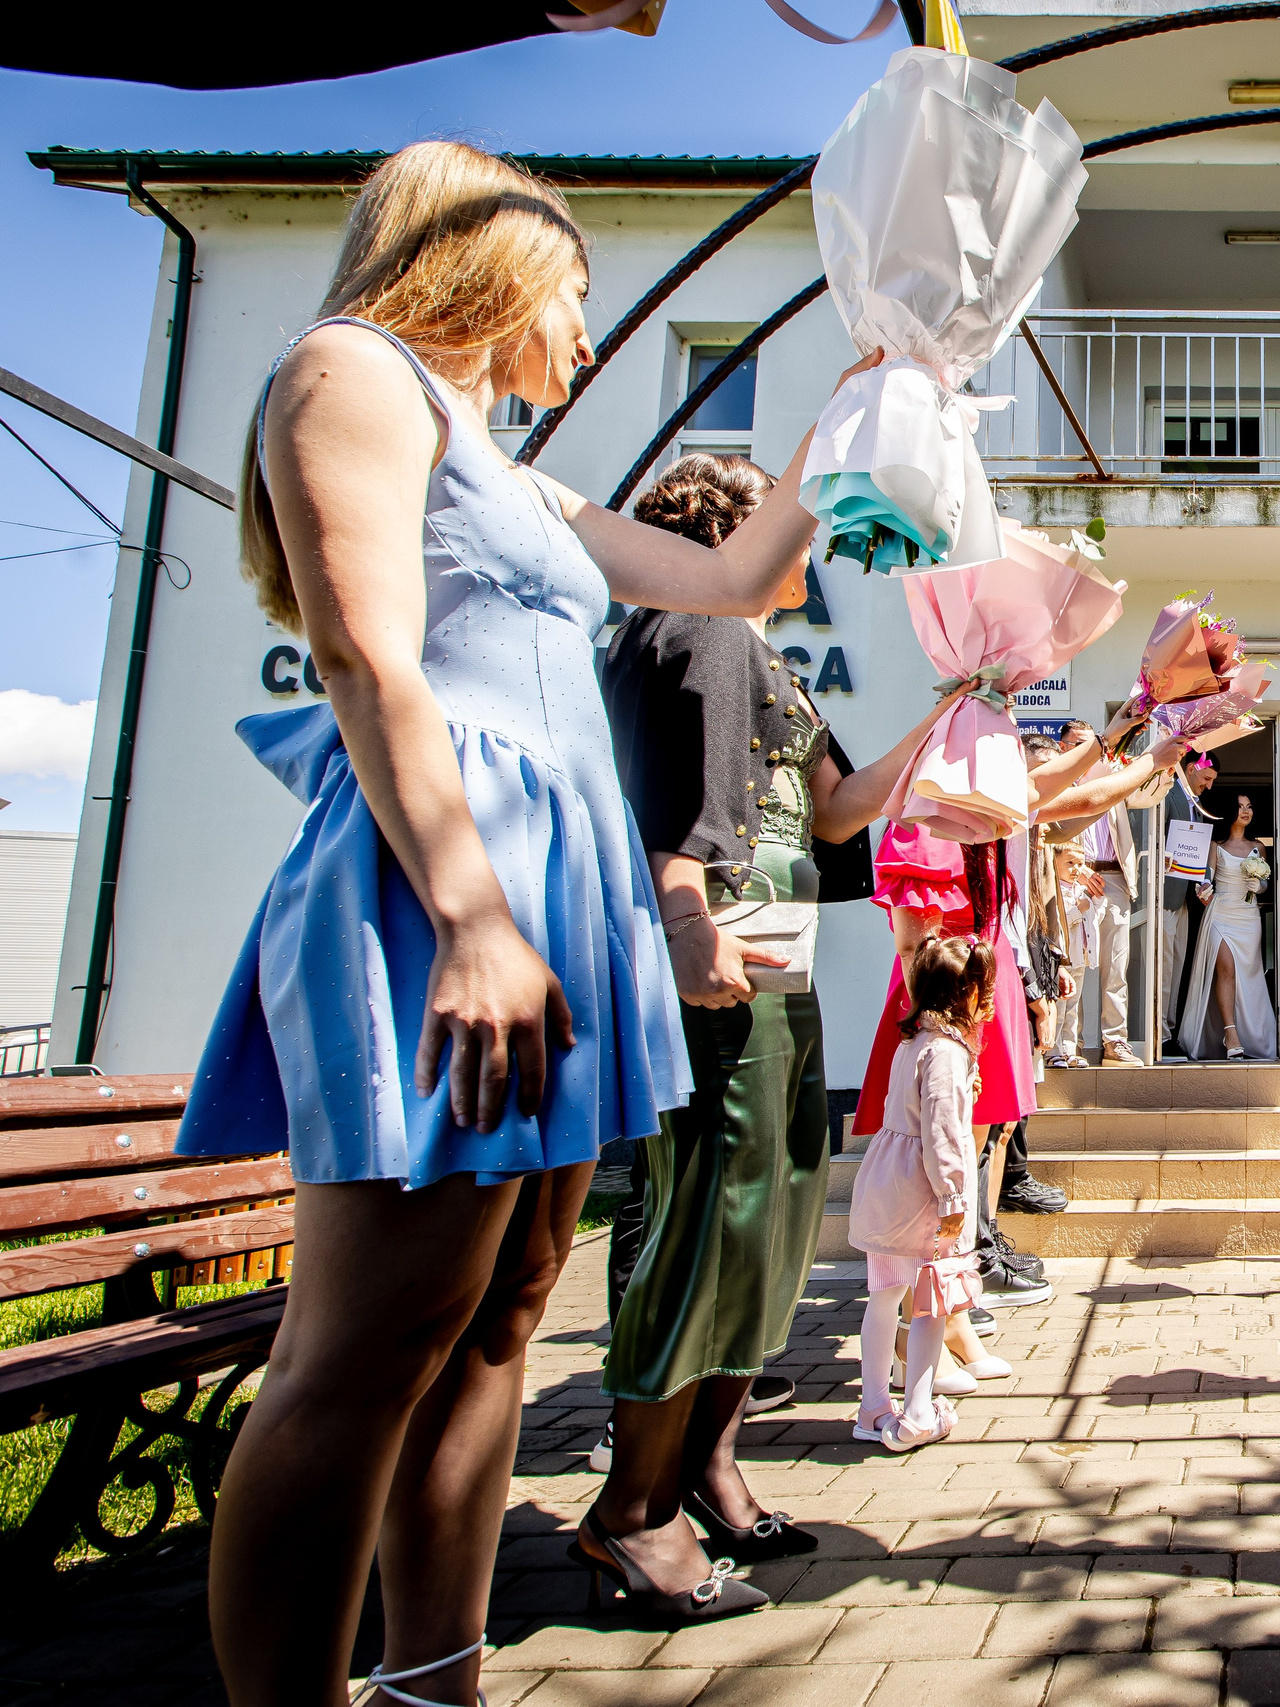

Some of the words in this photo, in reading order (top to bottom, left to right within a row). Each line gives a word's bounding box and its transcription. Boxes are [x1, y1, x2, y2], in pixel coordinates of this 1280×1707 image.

[1043, 725, 1056, 735] Nr.
[1177, 843, 1198, 852] Mapa
[1173, 850, 1201, 860] Familiei
